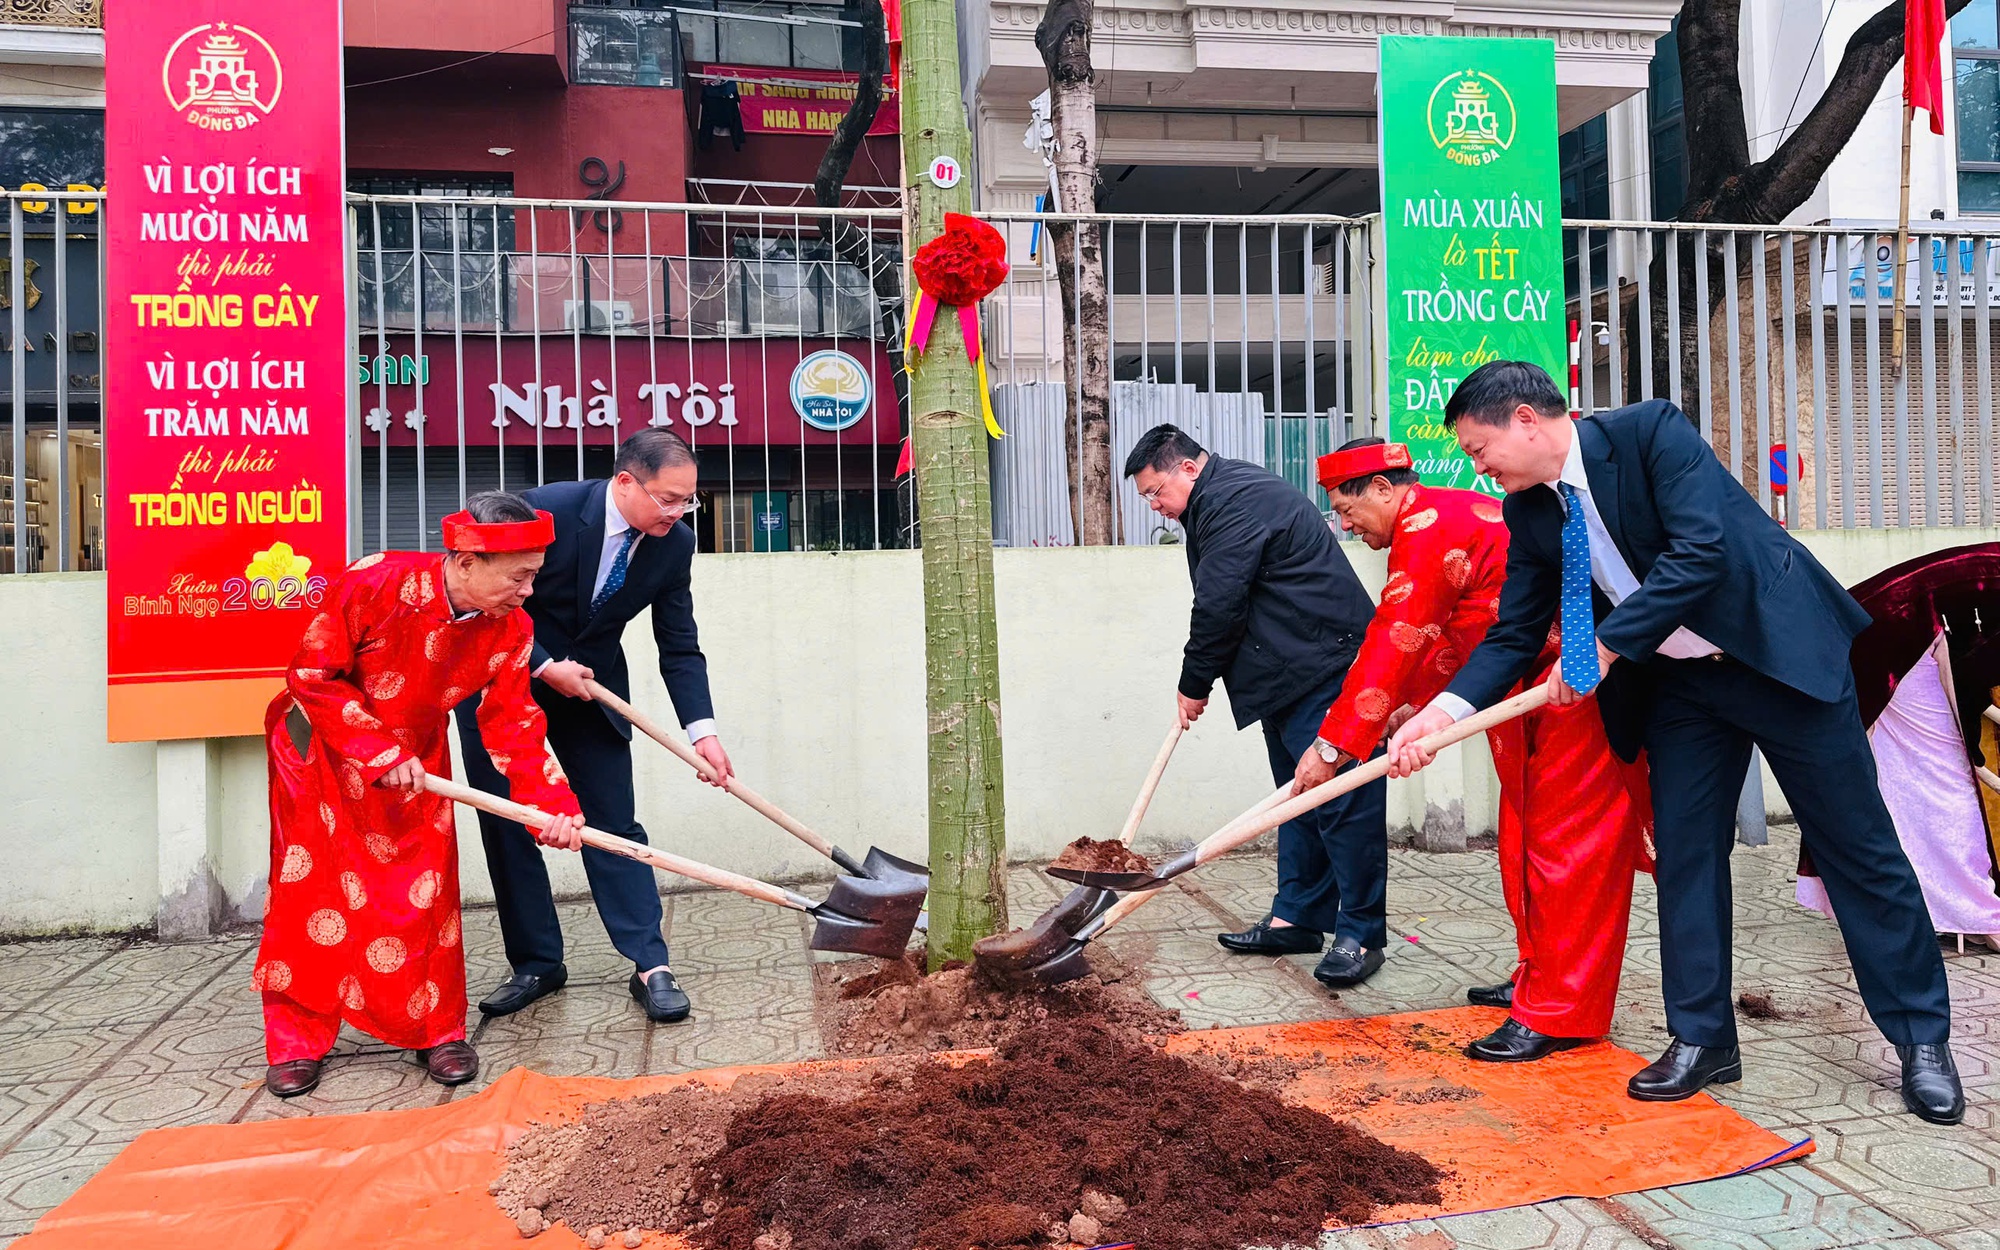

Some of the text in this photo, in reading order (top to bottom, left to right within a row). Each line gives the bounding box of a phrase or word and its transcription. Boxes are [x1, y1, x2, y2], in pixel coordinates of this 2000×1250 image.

[234, 112, 259, 129] ĐA
[762, 107, 849, 130] NHÀ HÀN
[936, 163, 953, 181] 01
[1482, 149, 1501, 165] ĐA
[143, 155, 301, 203] VÌ LỢI ÍCH
[140, 203, 309, 242] MƯỜI NĂM
[1403, 189, 1543, 228] MÙA XUÂN
[177, 248, 276, 287] thì phải
[1443, 231, 1519, 280] là TẾT
[131, 275, 319, 327] TRỒNG CÂY
[1402, 272, 1551, 322] TRỒNG CÂY
[1405, 335, 1501, 367] làm cho
[145, 351, 305, 399] VÌ LỢI ÍCH
[144, 399, 309, 436] TRĂM NĂM
[488, 379, 739, 428] Nhà Tôi
[178, 444, 278, 483] thì phải
[1412, 450, 1465, 488] càng
[129, 472, 322, 526] TRỒNG NGƯỜI
[124, 576, 328, 618] Bính Ngọ 2026
[167, 573, 218, 595] Xuân
